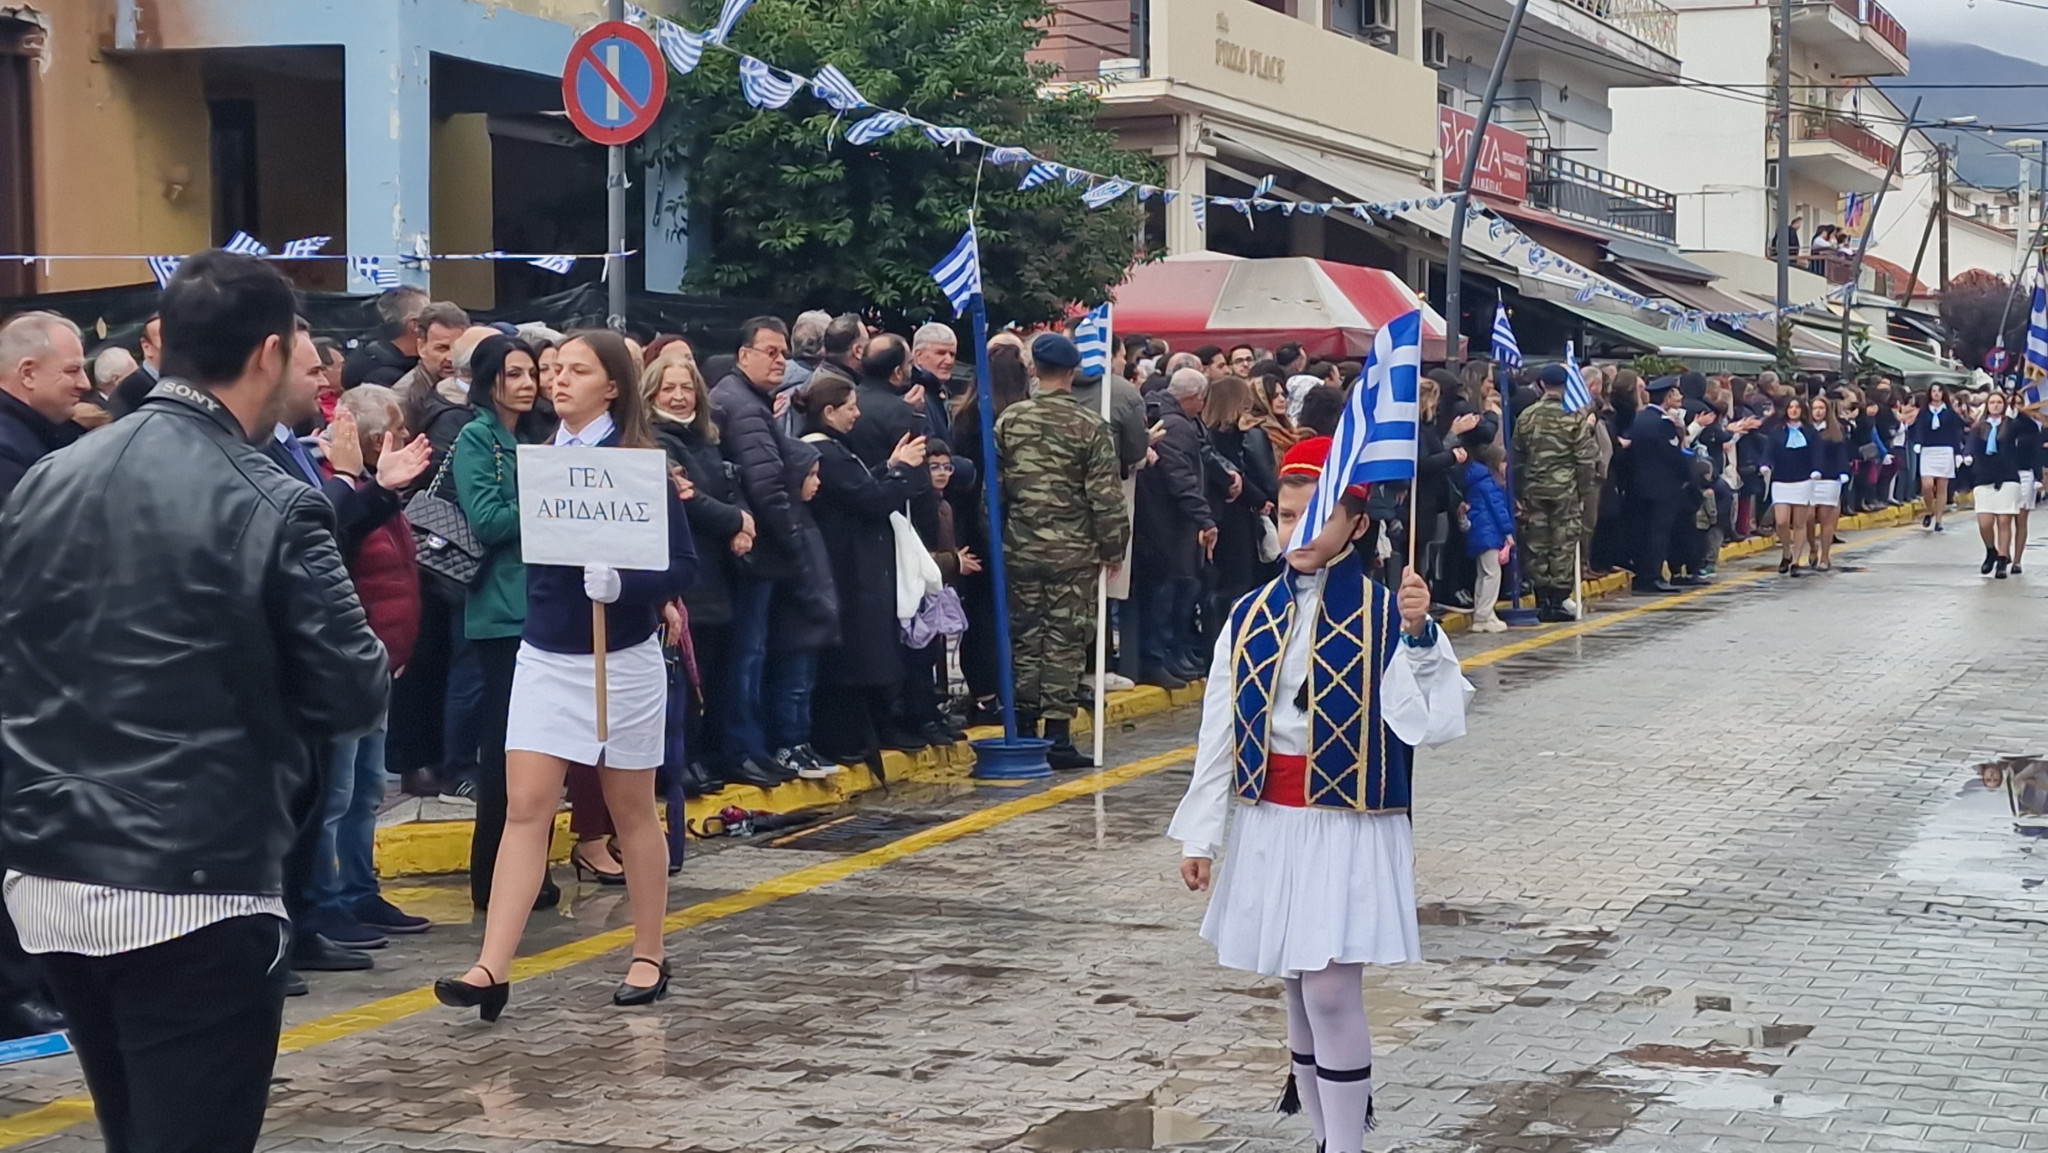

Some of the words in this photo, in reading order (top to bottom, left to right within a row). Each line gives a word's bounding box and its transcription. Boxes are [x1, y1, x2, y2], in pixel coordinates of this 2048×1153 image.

[162, 381, 220, 412] SONY
[568, 466, 614, 489] ΓΕΛ
[536, 497, 651, 523] ΑΡΙΔΑΙΑΣ
